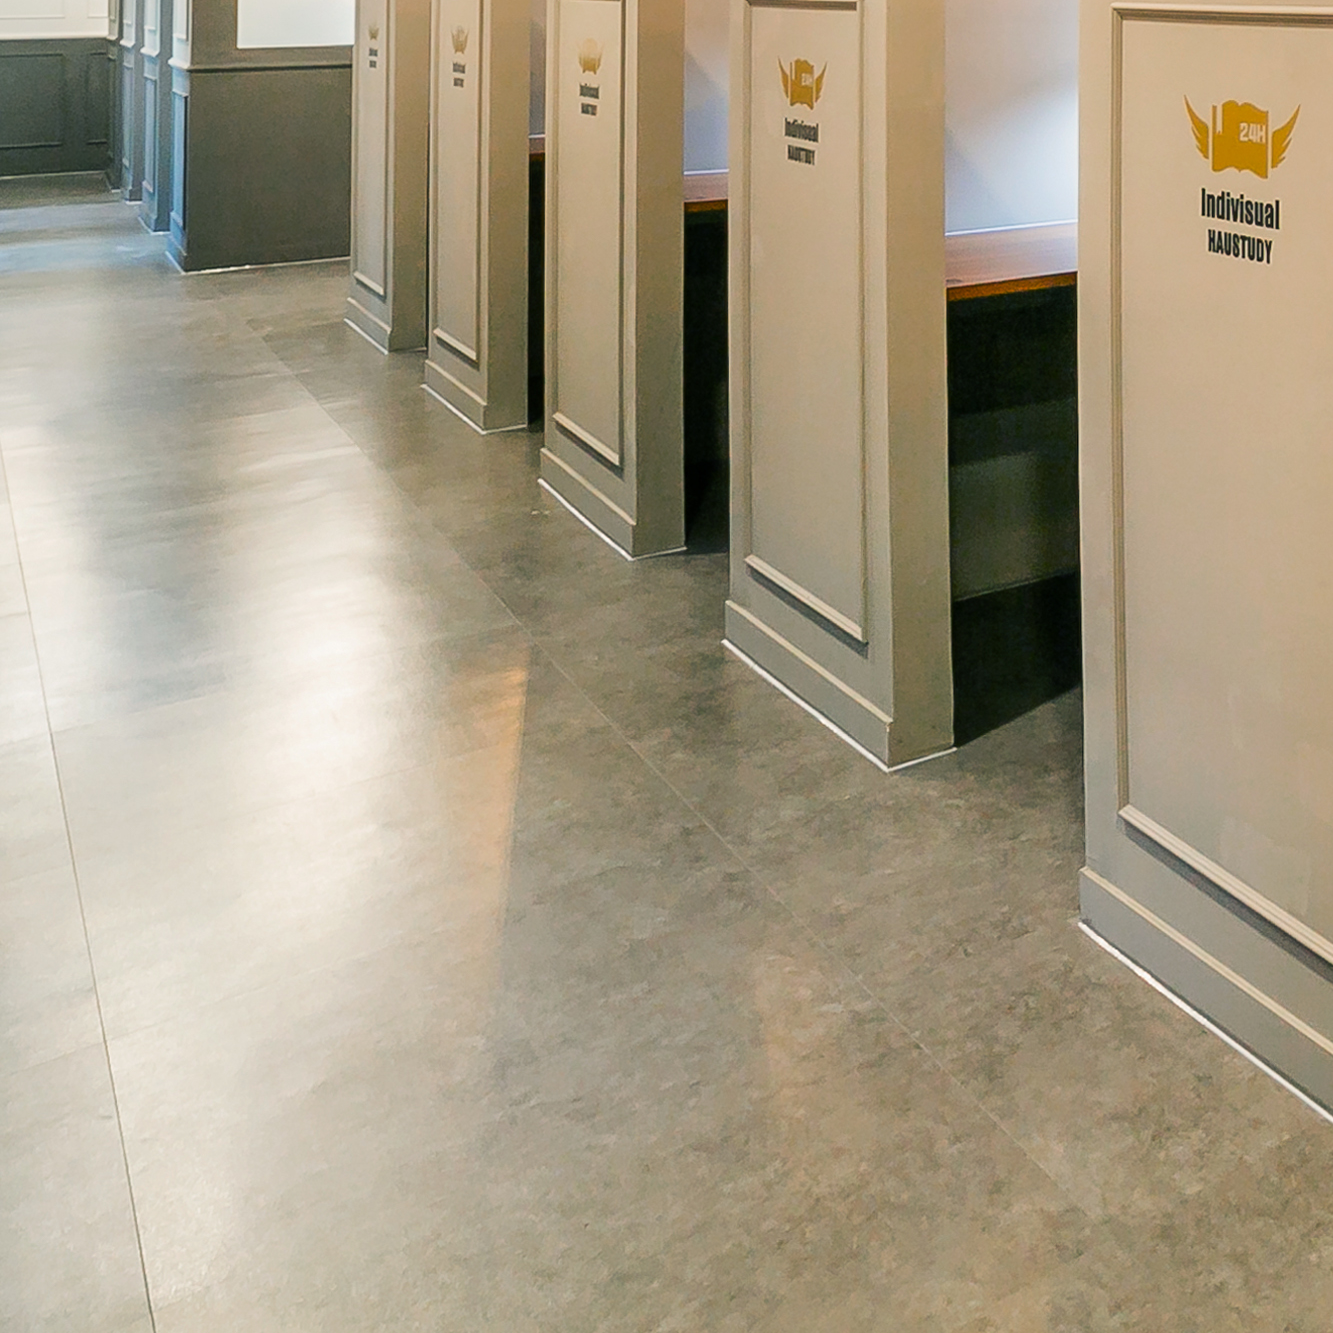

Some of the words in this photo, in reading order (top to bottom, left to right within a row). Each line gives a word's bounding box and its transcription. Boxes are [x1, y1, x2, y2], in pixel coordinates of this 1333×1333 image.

[1239, 122, 1266, 144] 24H
[1201, 187, 1280, 230] Indivisual
[1207, 228, 1273, 265] HAUSTUDY
